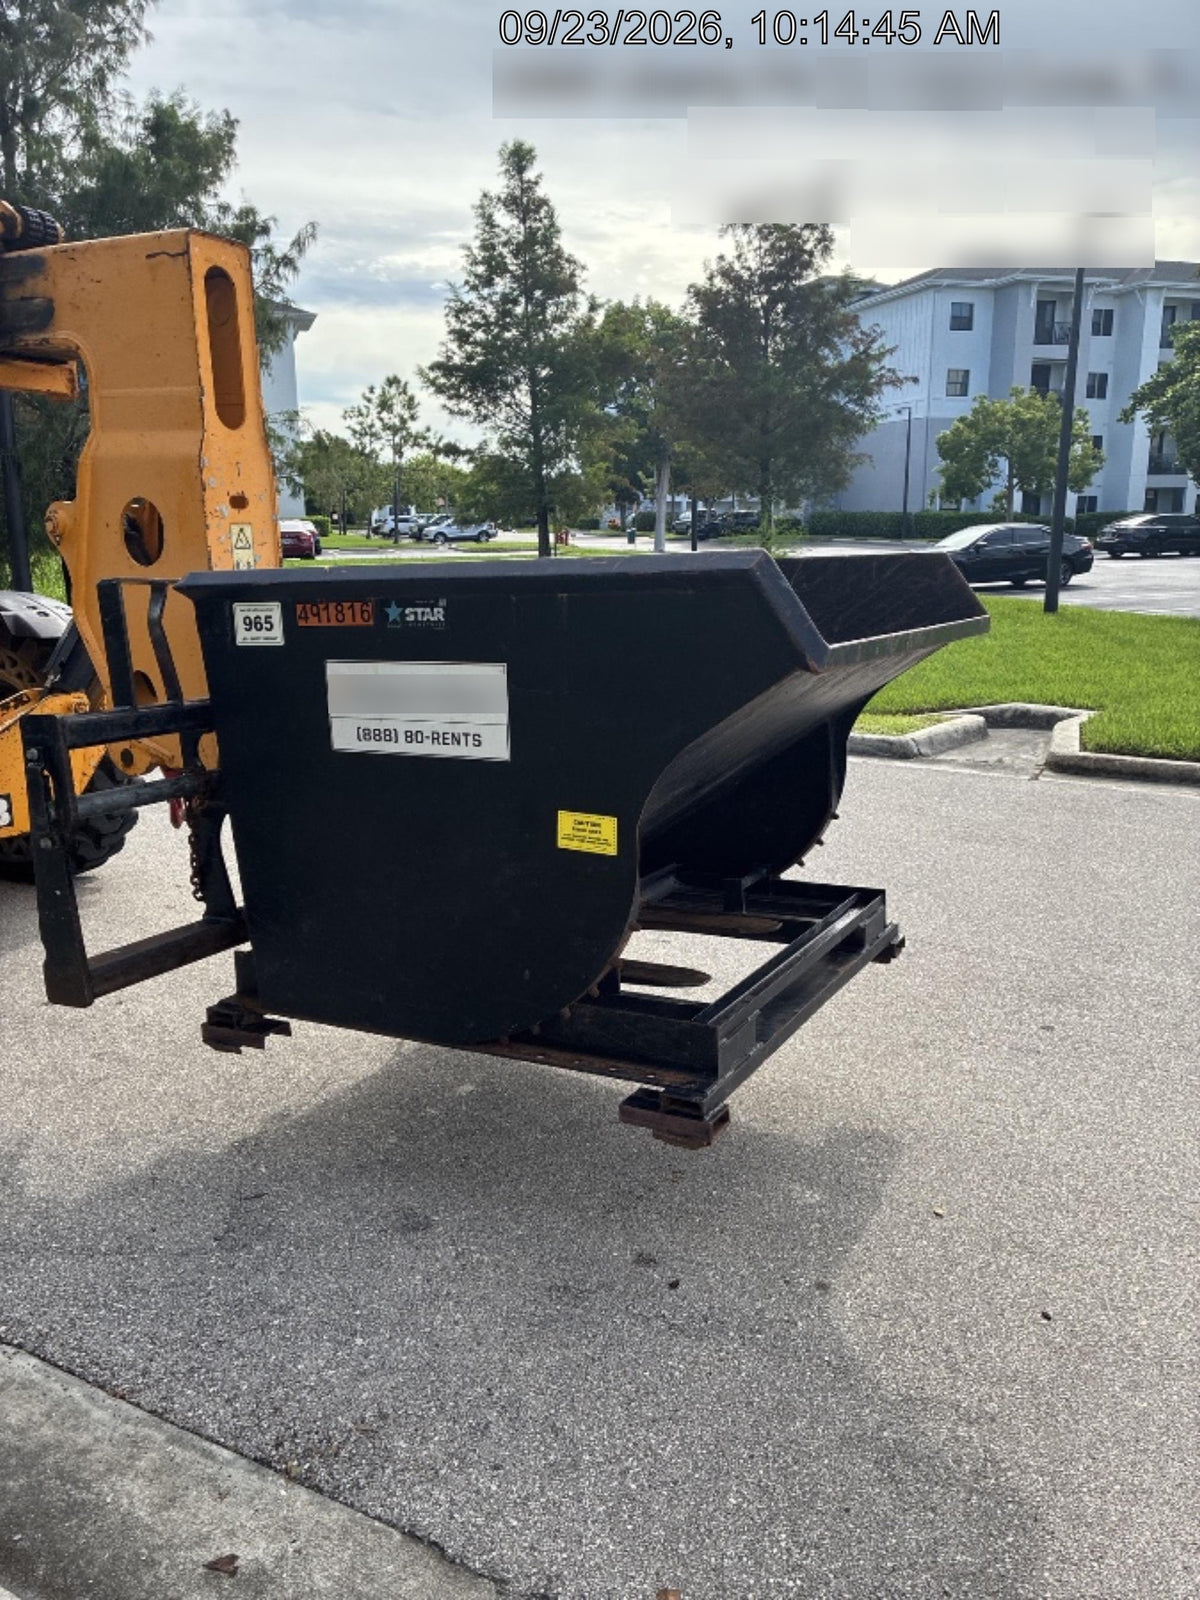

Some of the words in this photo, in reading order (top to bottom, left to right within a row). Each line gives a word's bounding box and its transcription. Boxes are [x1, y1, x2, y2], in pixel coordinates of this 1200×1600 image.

[298, 601, 371, 624] 491816
[404, 607, 445, 621] STAR
[242, 614, 274, 632] 965
[356, 726, 399, 744] (888)
[404, 730, 482, 748] 80-RENTS
